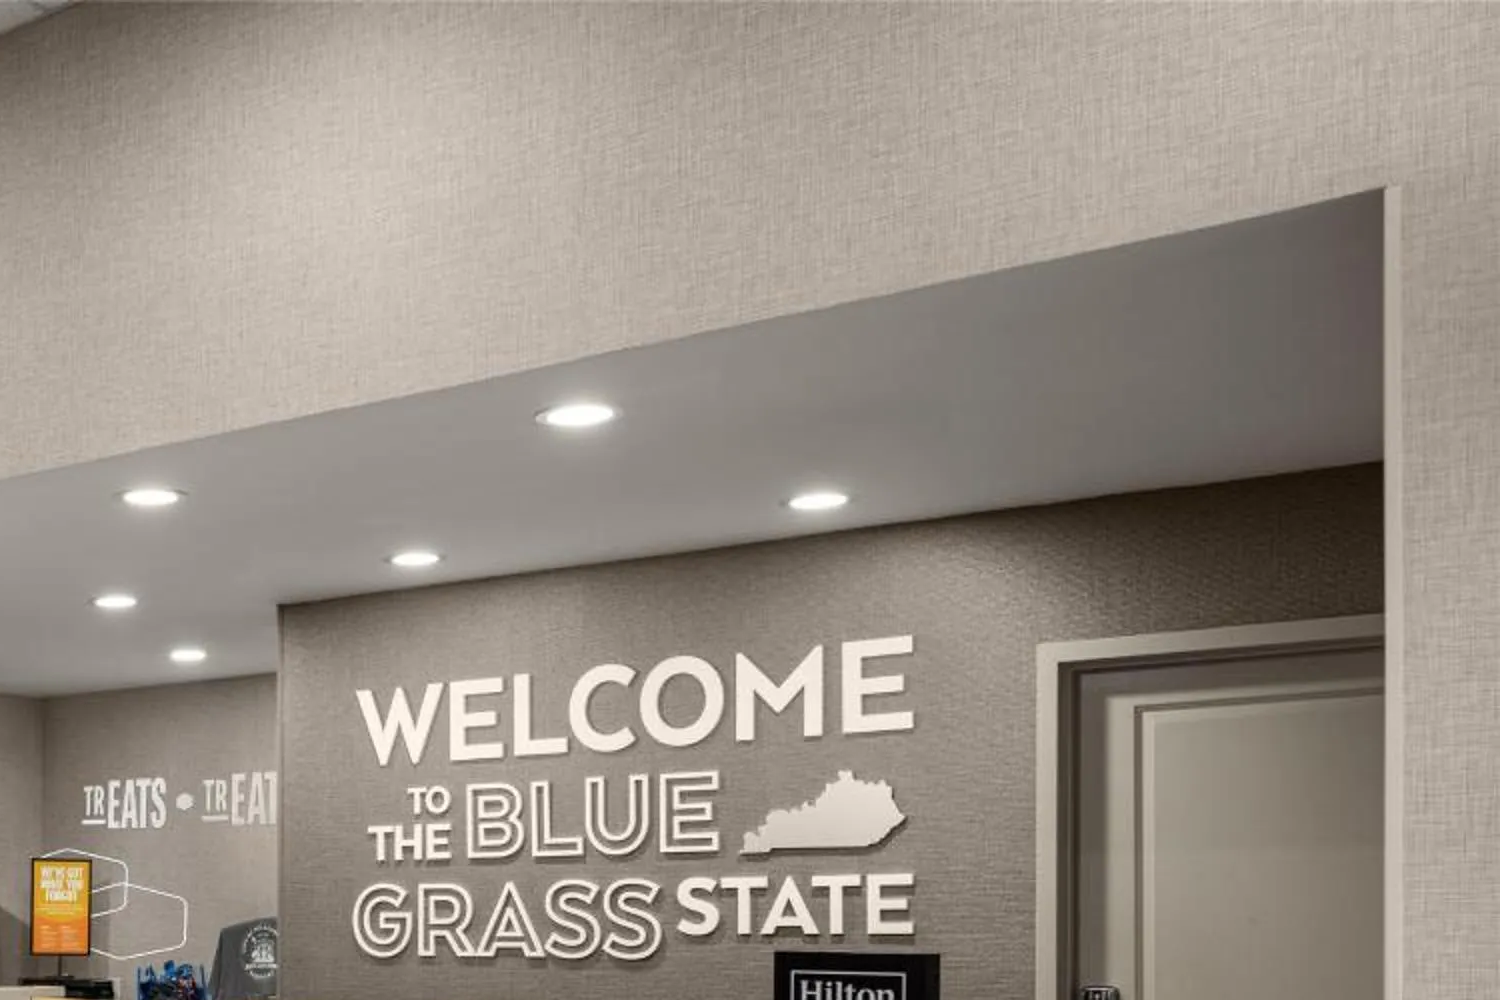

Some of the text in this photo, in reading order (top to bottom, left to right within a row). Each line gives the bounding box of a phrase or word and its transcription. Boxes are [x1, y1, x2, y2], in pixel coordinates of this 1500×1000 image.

[356, 635, 914, 766] WELCOME
[83, 777, 167, 829] TREATS
[368, 769, 720, 861] THE BLUE
[408, 784, 451, 815] TO
[353, 877, 663, 961] GRASS
[676, 872, 915, 936] STATE
